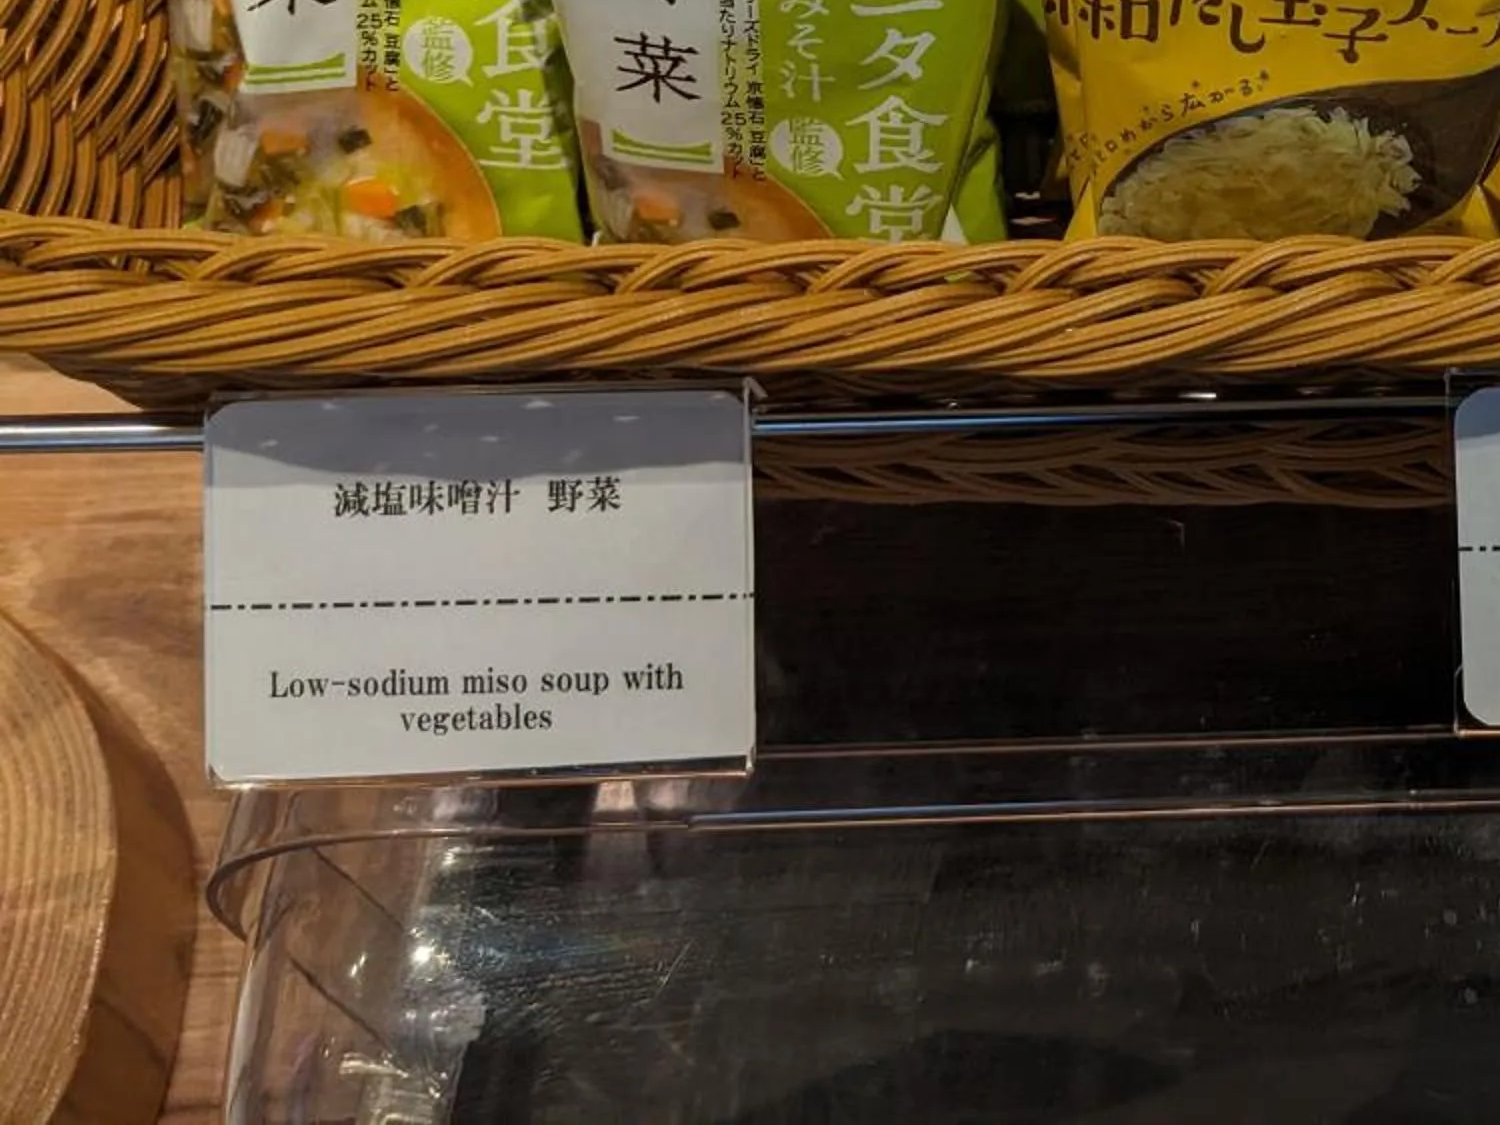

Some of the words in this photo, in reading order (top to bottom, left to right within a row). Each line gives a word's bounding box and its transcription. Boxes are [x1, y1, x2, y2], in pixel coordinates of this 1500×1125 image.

[334, 478, 520, 518] 減塩味噌汁
[547, 475, 622, 513] 野菜
[269, 670, 450, 699] Low-sodium
[461, 666, 528, 696] miso
[540, 673, 610, 696] soup
[623, 663, 685, 692] with
[400, 703, 553, 736] vegetables
